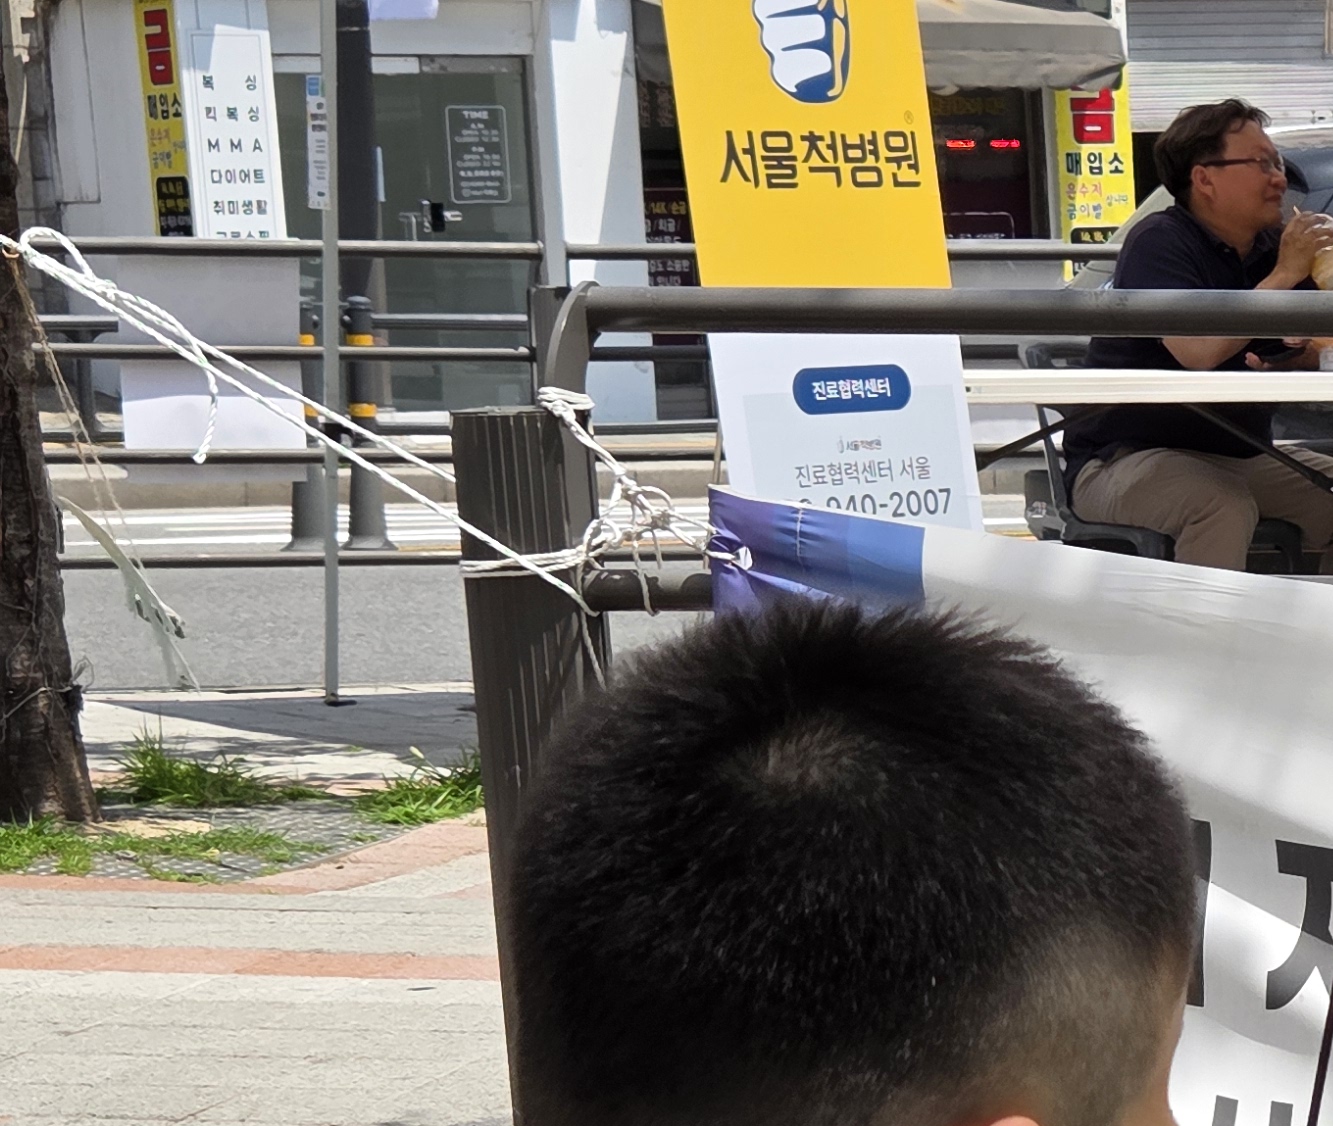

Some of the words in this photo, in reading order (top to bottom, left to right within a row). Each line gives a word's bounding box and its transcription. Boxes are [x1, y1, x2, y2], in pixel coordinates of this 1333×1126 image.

[719, 130, 922, 189] 서울척병원
[1066, 152, 1124, 175] 매입소
[211, 169, 266, 184] 다이어트
[213, 200, 268, 216] 취미생활
[811, 377, 892, 400] 진료협력센터
[795, 458, 894, 488] 진료협력센터
[900, 456, 931, 481] 서울
